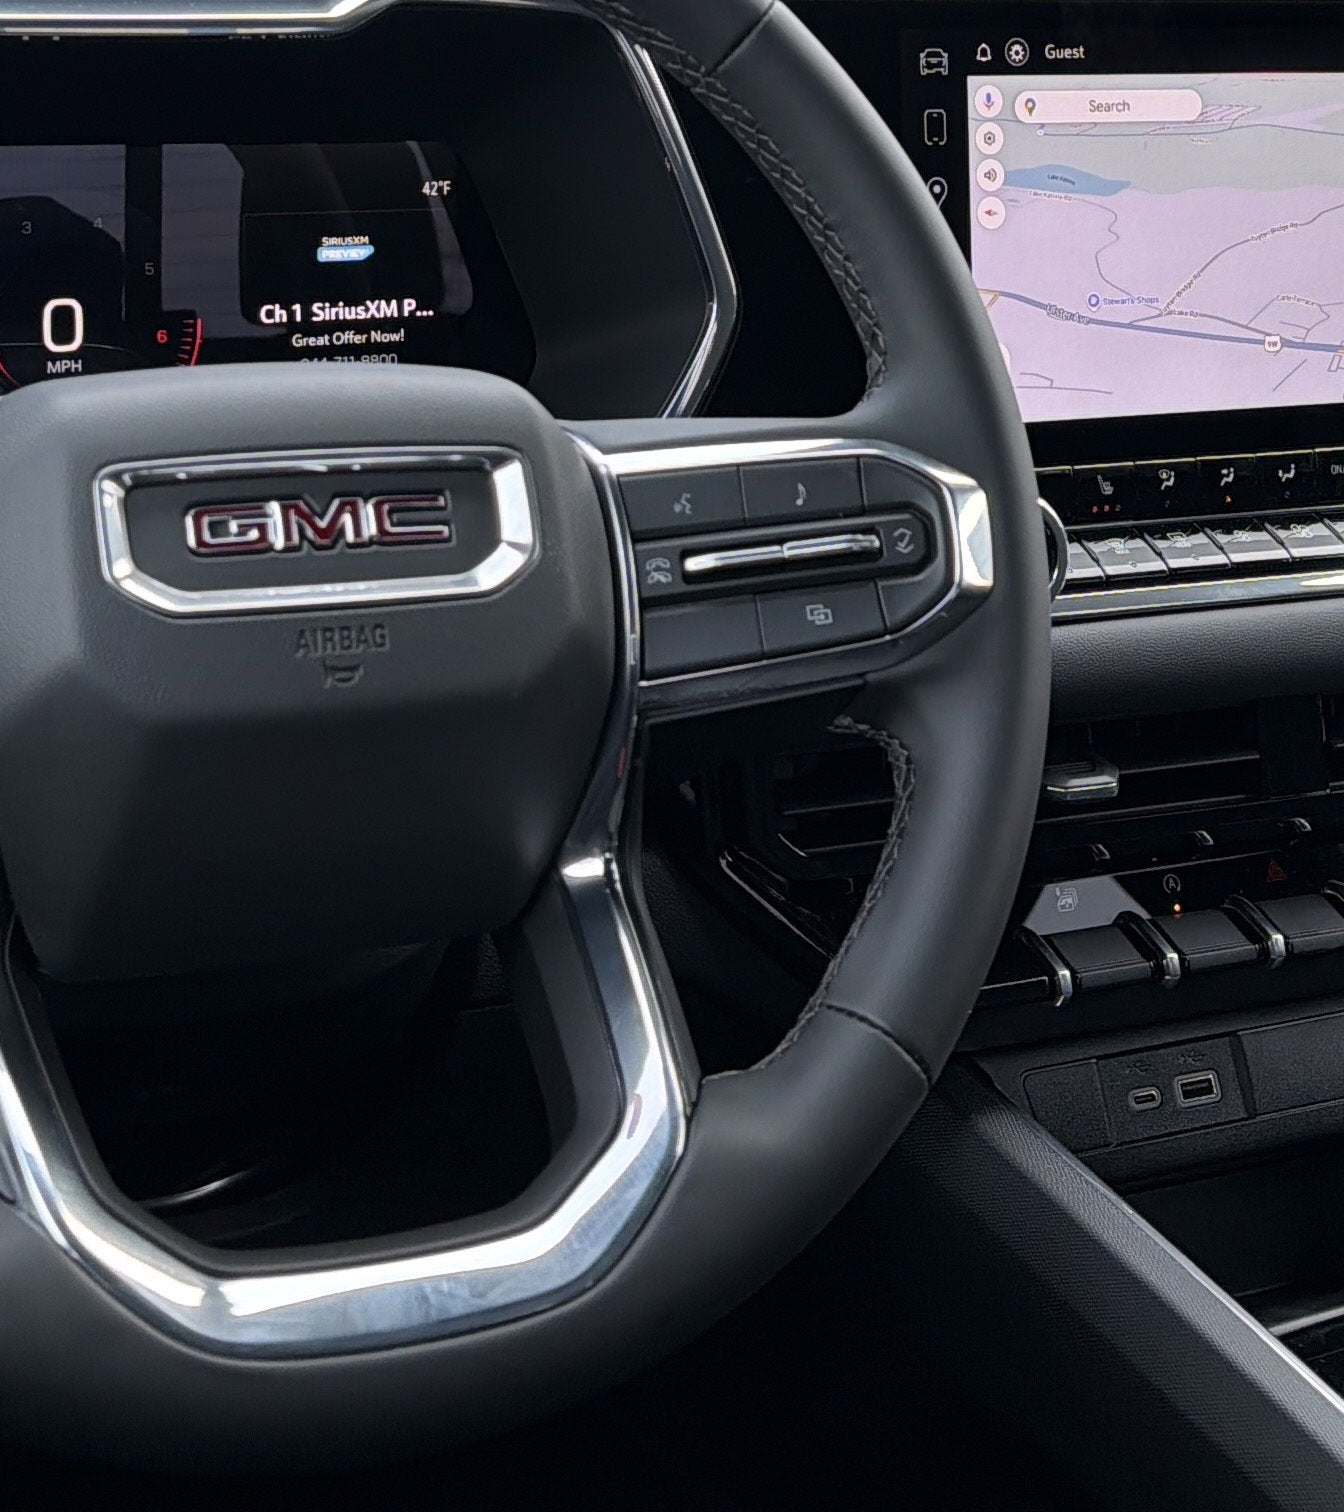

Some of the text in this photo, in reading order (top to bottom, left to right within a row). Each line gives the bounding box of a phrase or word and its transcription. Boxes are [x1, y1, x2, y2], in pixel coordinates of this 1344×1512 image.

[1044, 44, 1086, 60] Guest
[1088, 99, 1131, 113] Search
[422, 180, 452, 196] 42°F
[21, 221, 32, 235] 3
[93, 217, 103, 230] 4
[321, 236, 369, 246] SIRIUSXM
[144, 263, 155, 276] 5
[1136, 295, 1159, 305] Shops
[259, 298, 435, 324] Ch 1 SiriusXM P...
[1072, 310, 1090, 325] Ave
[42, 297, 84, 353] 0
[156, 329, 168, 343] 6
[291, 328, 405, 348] Great Offer Now!
[46, 360, 82, 375] MPH
[184, 493, 451, 554] GMC
[295, 622, 391, 658] AIRBAG
